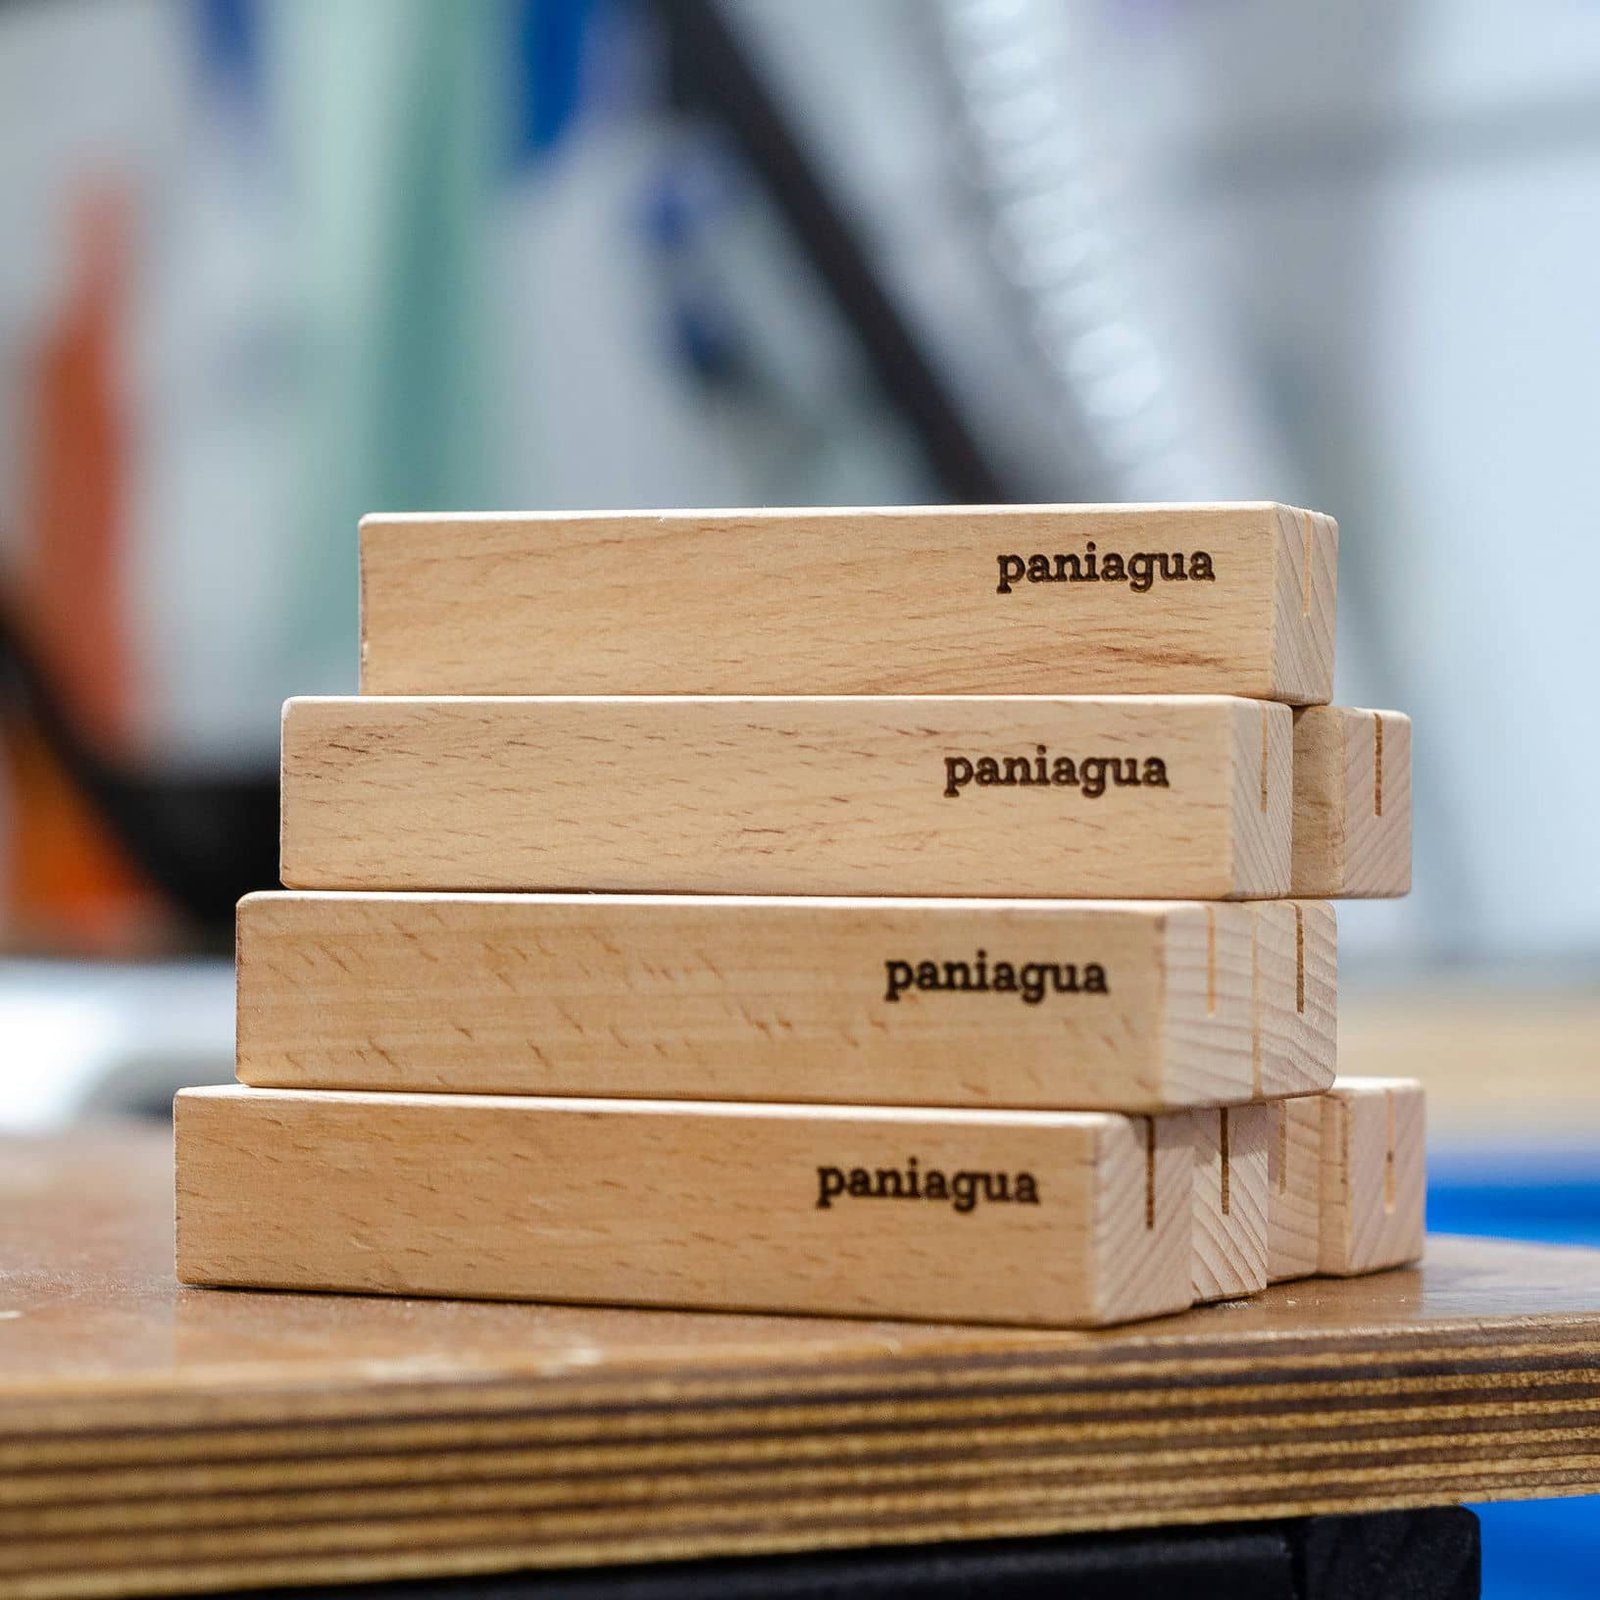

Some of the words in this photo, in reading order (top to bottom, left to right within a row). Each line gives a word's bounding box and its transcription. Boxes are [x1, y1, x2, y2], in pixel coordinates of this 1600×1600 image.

[997, 541, 1216, 595] paniagua
[944, 744, 1170, 799] paniagua
[884, 949, 1110, 1006] paniagua
[815, 1156, 1041, 1215] paniagua
